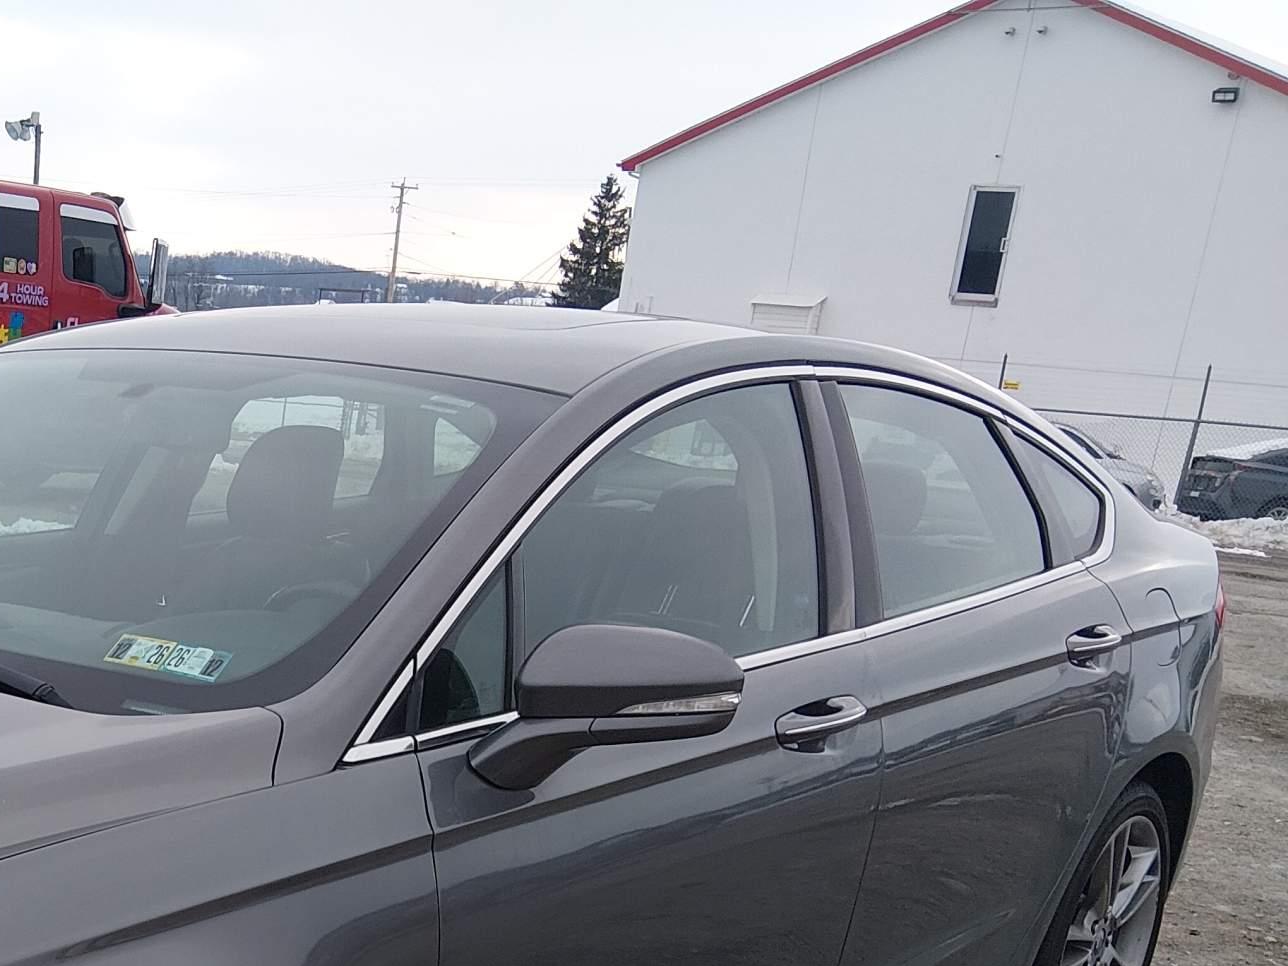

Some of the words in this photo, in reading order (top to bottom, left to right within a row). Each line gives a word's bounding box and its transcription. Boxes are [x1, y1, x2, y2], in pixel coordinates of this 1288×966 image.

[16, 284, 44, 295] HOUR
[10, 293, 49, 306] TOWING
[146, 644, 171, 665] 26
[167, 647, 191, 668] 26
